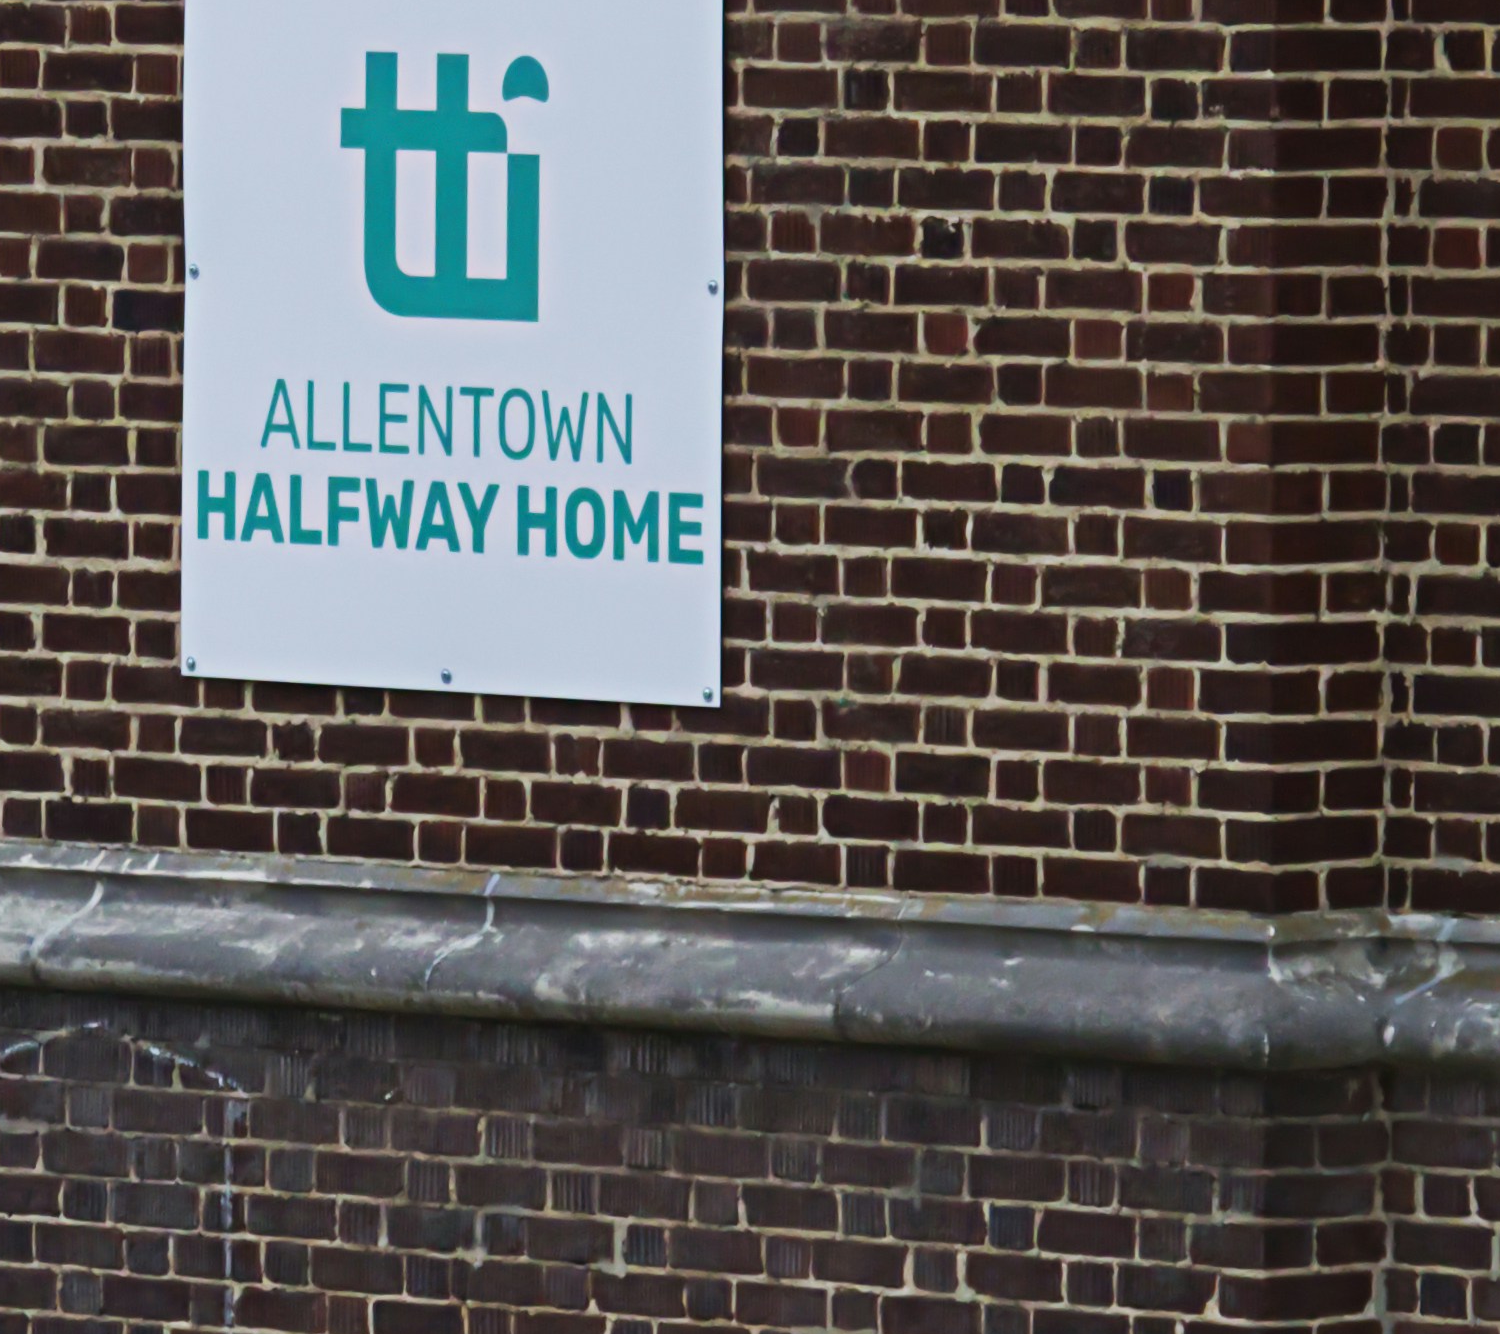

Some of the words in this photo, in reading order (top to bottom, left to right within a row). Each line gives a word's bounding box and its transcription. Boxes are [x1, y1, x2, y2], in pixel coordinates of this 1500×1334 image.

[340, 51, 549, 323] tti
[261, 378, 634, 465] ALLENTOWN
[198, 470, 500, 555] HALFWAY
[516, 486, 705, 565] HOME
